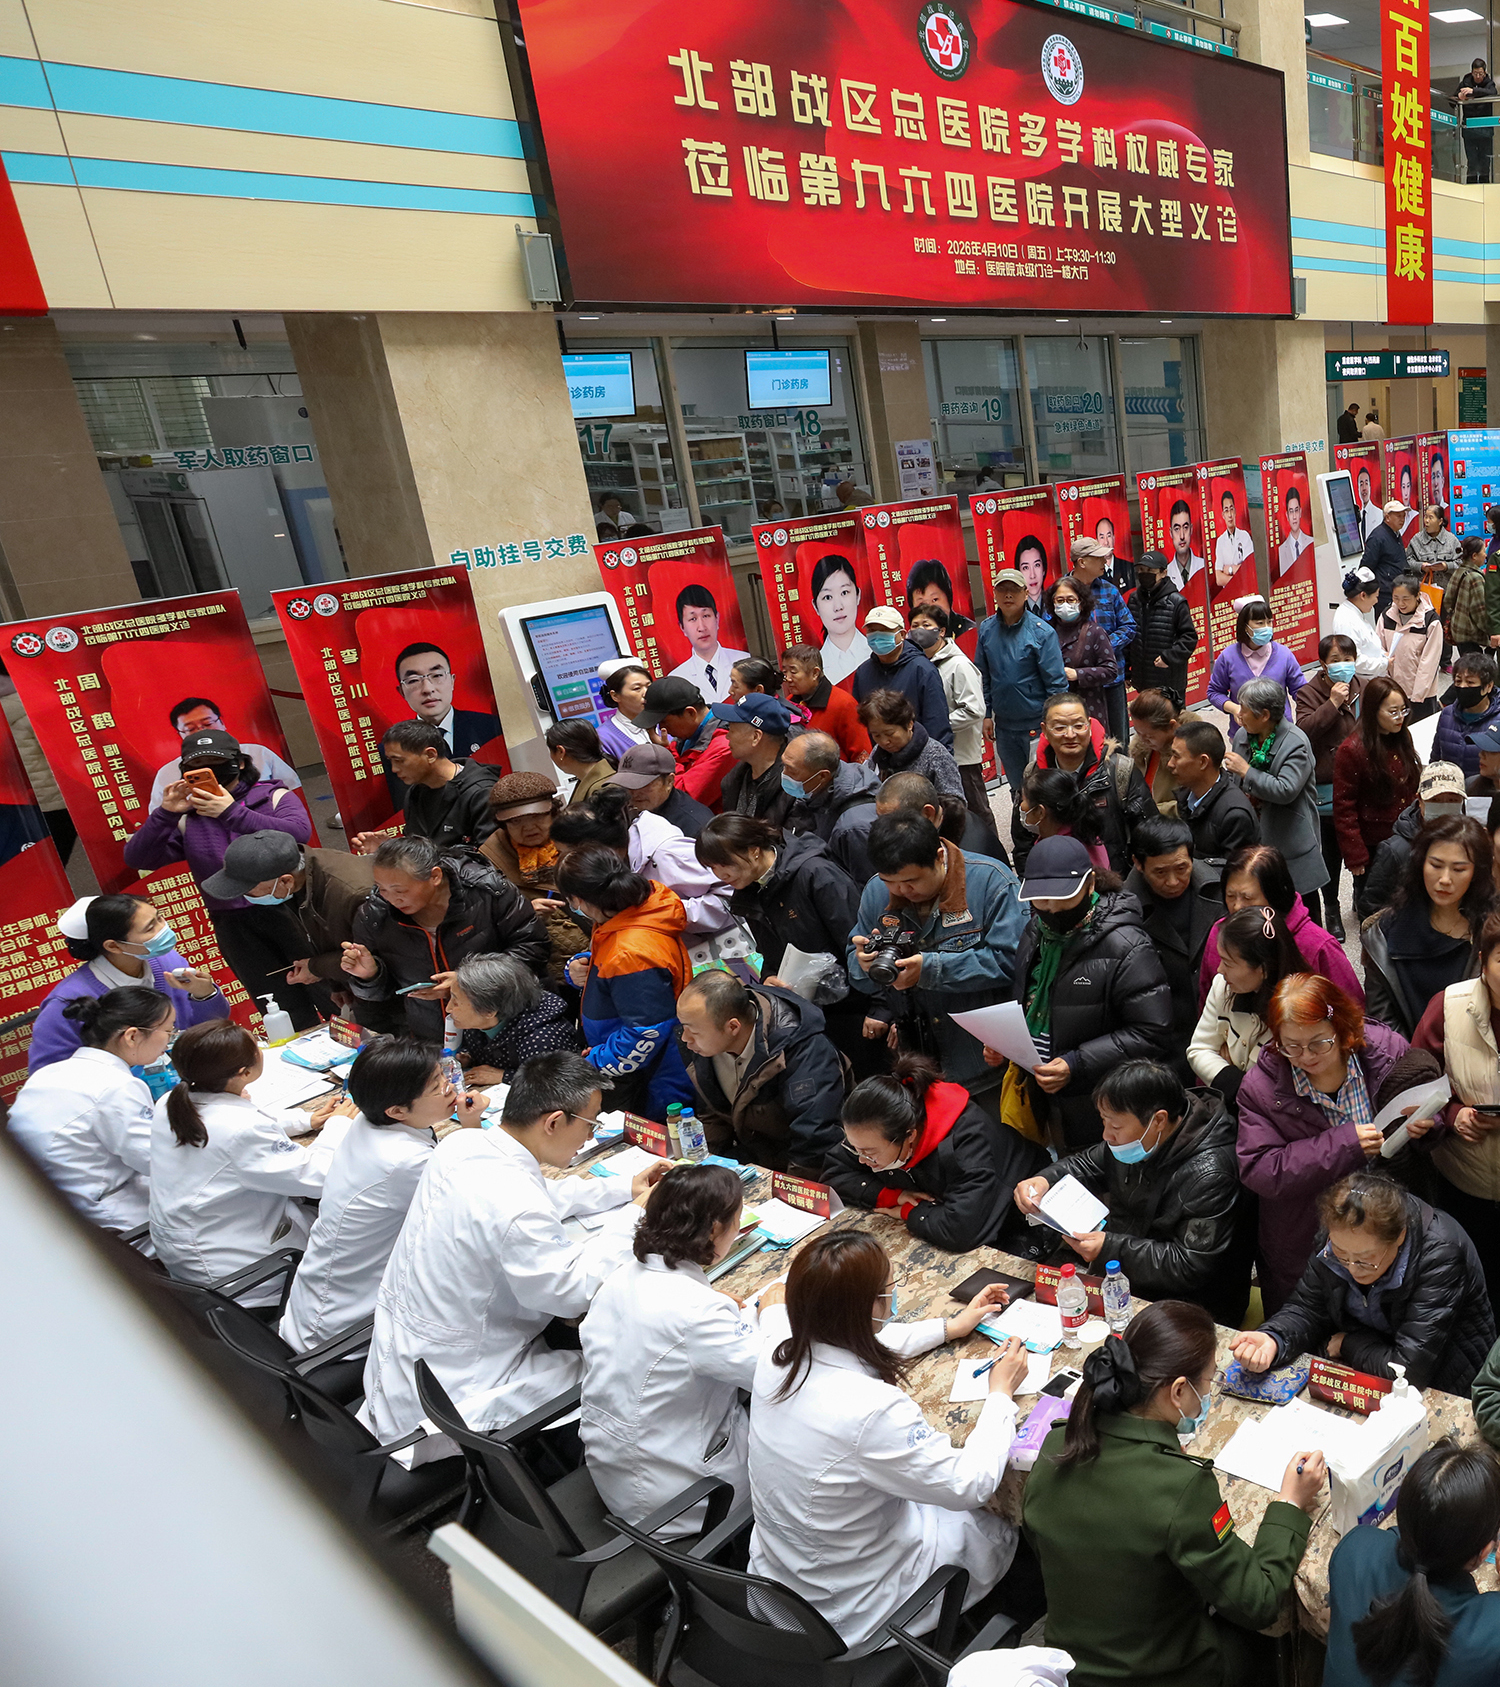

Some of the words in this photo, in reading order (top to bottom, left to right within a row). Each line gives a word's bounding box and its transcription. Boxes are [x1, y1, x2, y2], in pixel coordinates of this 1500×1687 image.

[667, 47, 1236, 190] 北部战区总医院多学科权威专家
[1388, 0, 1427, 282] 百姓健康
[681, 137, 1239, 244] 莅临第九六四医院开展大型义诊
[567, 385, 606, 399] 诊药房
[771, 378, 809, 391] 门诊药房
[940, 400, 979, 417] 用药咨询
[981, 398, 1002, 422] 19
[1082, 391, 1102, 414] 20
[579, 423, 613, 455] 17
[738, 412, 788, 430] 取药窗口
[793, 410, 822, 438] 18
[174, 441, 315, 471] 军人取药窗口
[449, 534, 590, 573] 自助挂号交费
[341, 576, 457, 602] 北部战区总医院多学科专家团队
[343, 589, 428, 611] 莅临第九六四医院义诊
[891, 570, 906, 608] 张宁
[80, 603, 227, 636] 北部战区总医院多学科专家团队
[84, 619, 191, 646] 莅临第九六四医院义诊
[320, 647, 367, 781] 北部战区总医院肾脏病科
[357, 715, 385, 776] 副主任医师
[102, 743, 141, 811] 副主任医师
[787, 1193, 815, 1210] 段丽春
[1333, 1391, 1366, 1410] 巩阳
